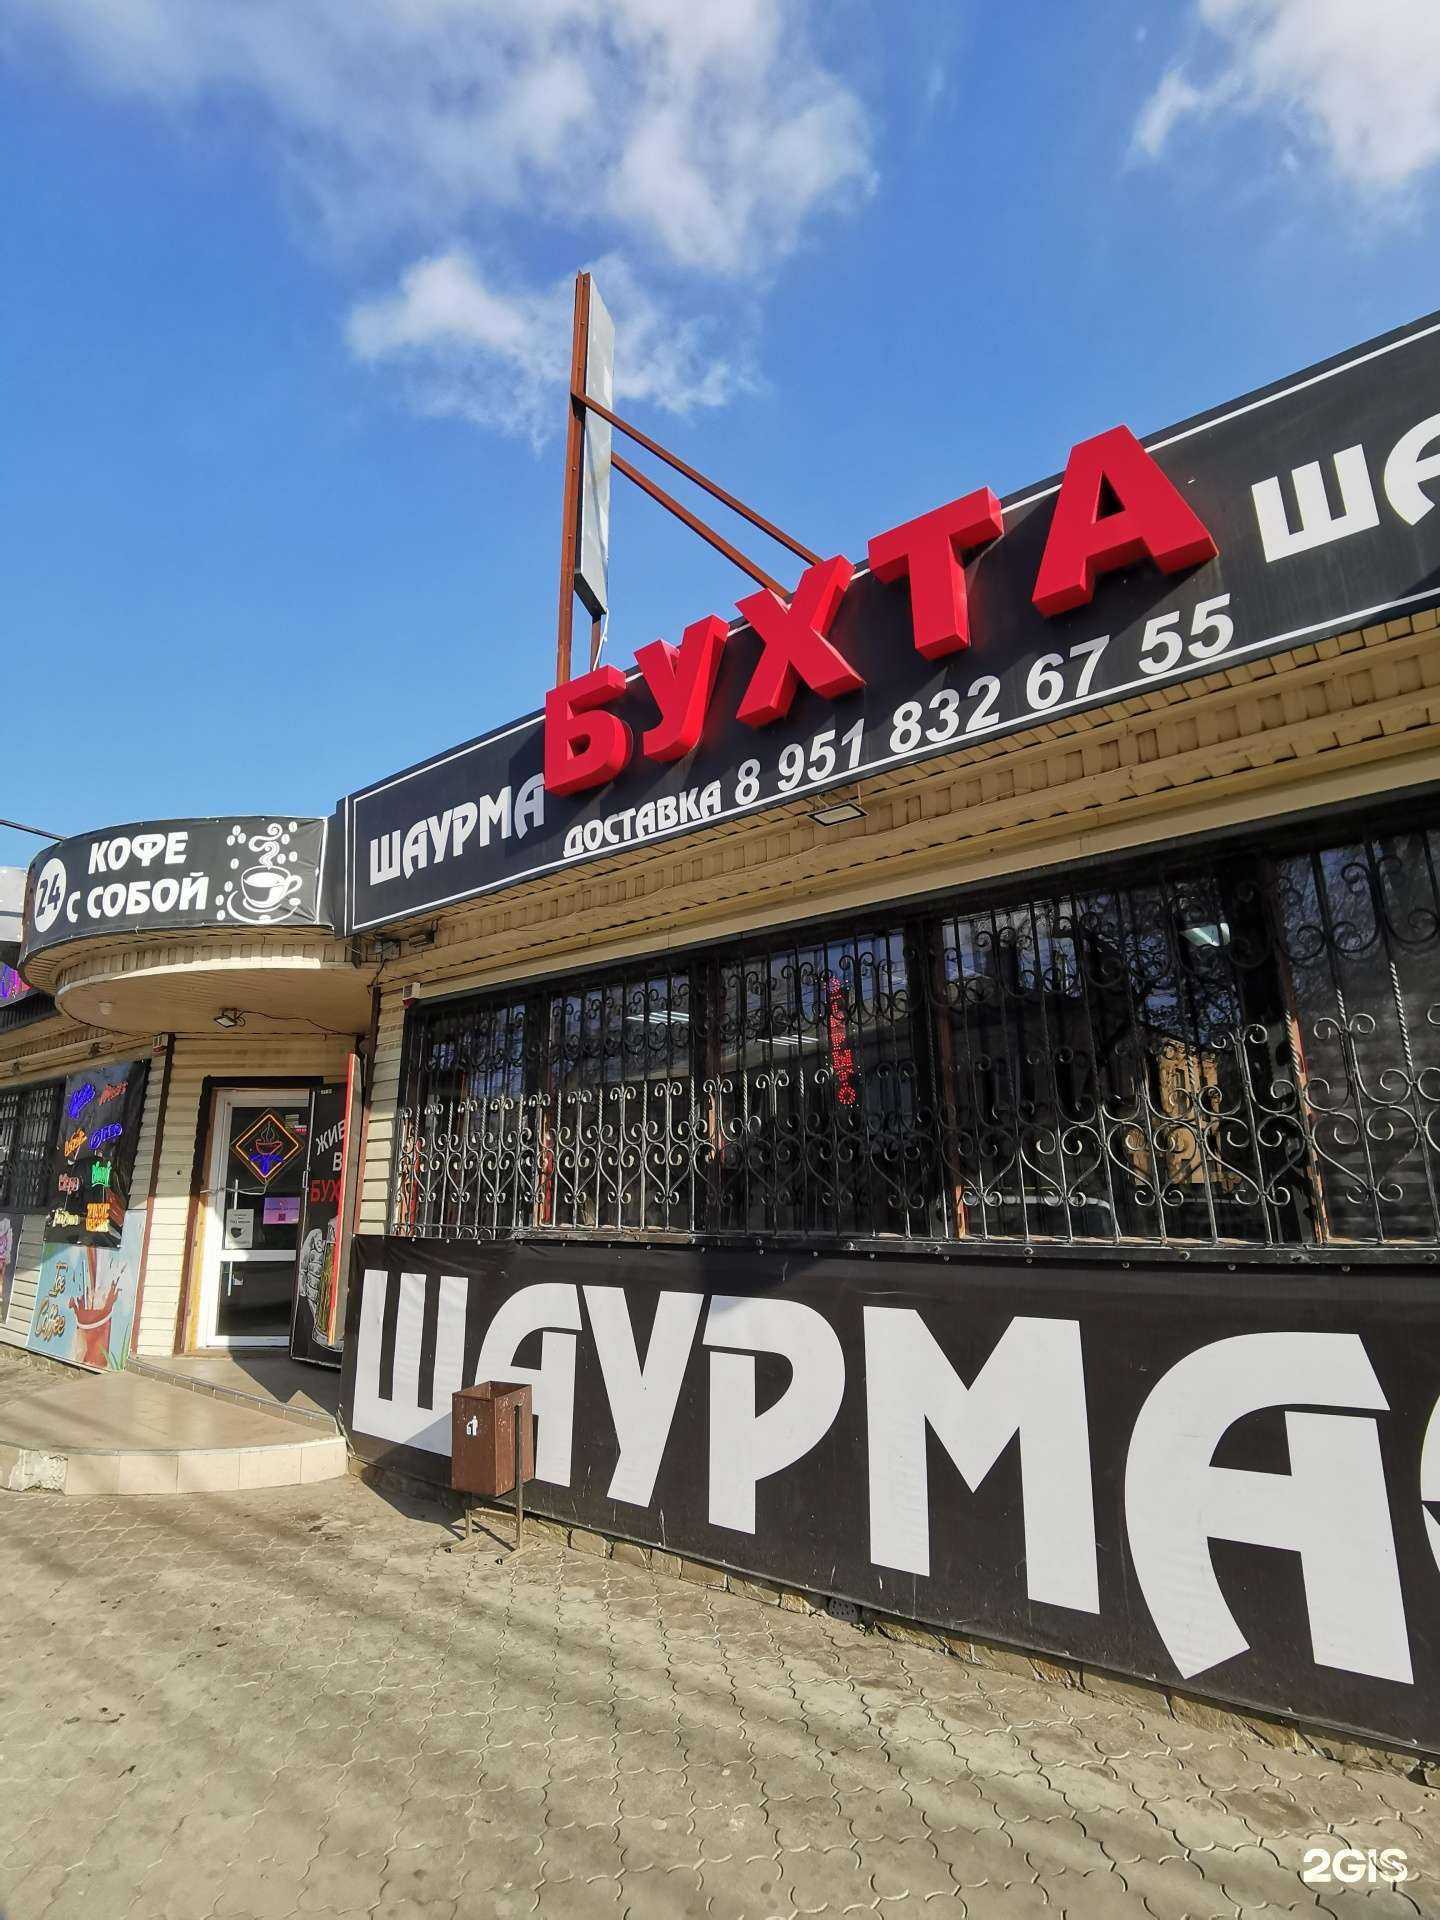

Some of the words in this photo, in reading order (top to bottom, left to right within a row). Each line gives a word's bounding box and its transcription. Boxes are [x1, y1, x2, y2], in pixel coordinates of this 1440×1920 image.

[544, 424, 1219, 796] БУХТА
[563, 780, 723, 858] ДОСТАВКА
[734, 758, 761, 806] 8
[777, 718, 865, 790] 951
[889, 674, 1001, 754] 832
[1025, 634, 1111, 710] 67
[1138, 593, 1234, 675] 55
[87, 831, 188, 875] КОФЕ
[369, 772, 545, 886] ШАУРМА
[36, 873, 61, 919] 24
[87, 871, 210, 919] СОБОЙ
[35, 1295, 66, 1343] Coffee
[353, 1269, 1414, 1683] ШАУРМА
